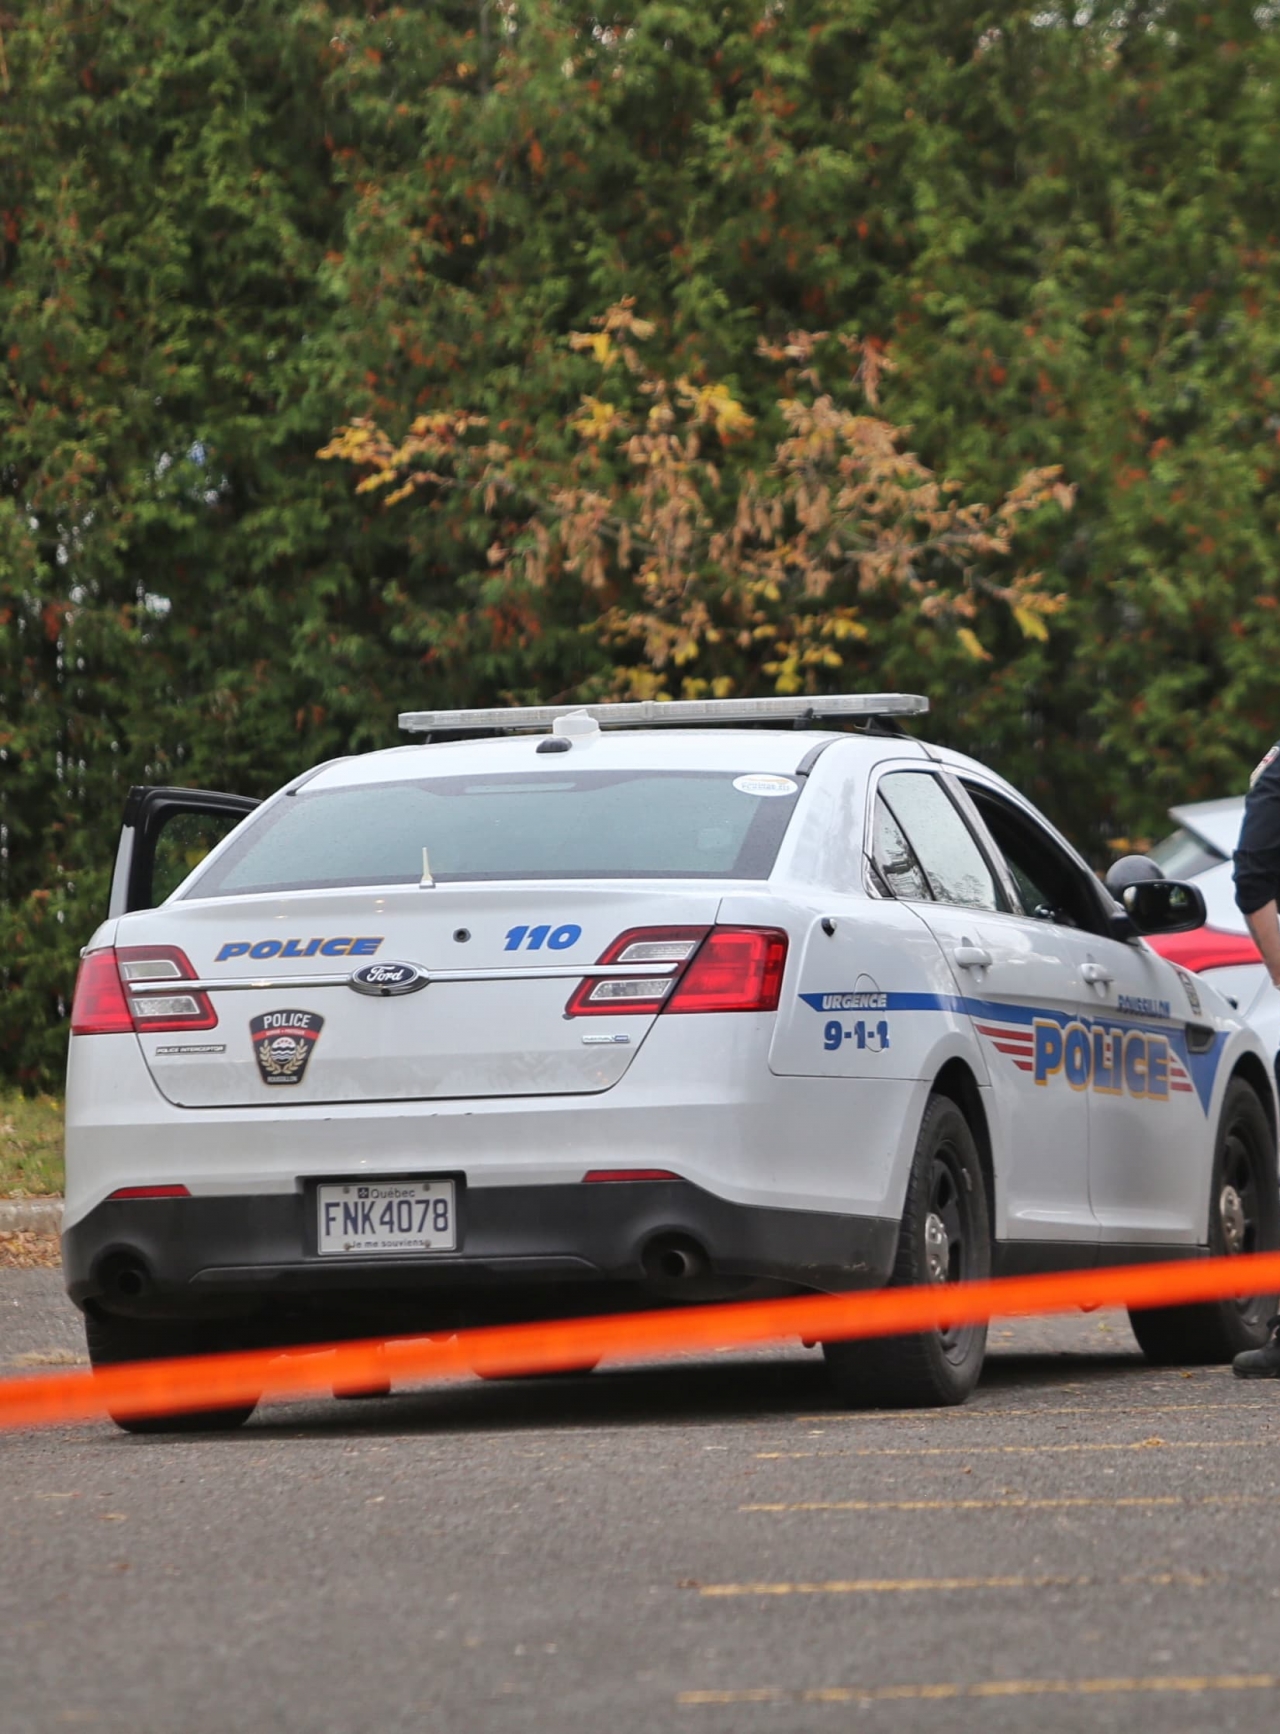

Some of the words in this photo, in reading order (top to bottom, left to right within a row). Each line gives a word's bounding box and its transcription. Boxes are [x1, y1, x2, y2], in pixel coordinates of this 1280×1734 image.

[503, 924, 582, 951] 110
[215, 937, 385, 962] POLICE
[366, 965, 404, 983] Ford
[822, 993, 887, 1010] URGENCE
[263, 1012, 312, 1029] POLICE
[824, 1020, 889, 1051] 9-1-1
[1032, 1017, 1170, 1101] POLICE
[370, 1188, 416, 1199] Québec
[324, 1198, 448, 1236] FNK4078
[351, 1240, 362, 1249] Je
[381, 1238, 424, 1248] souviens
